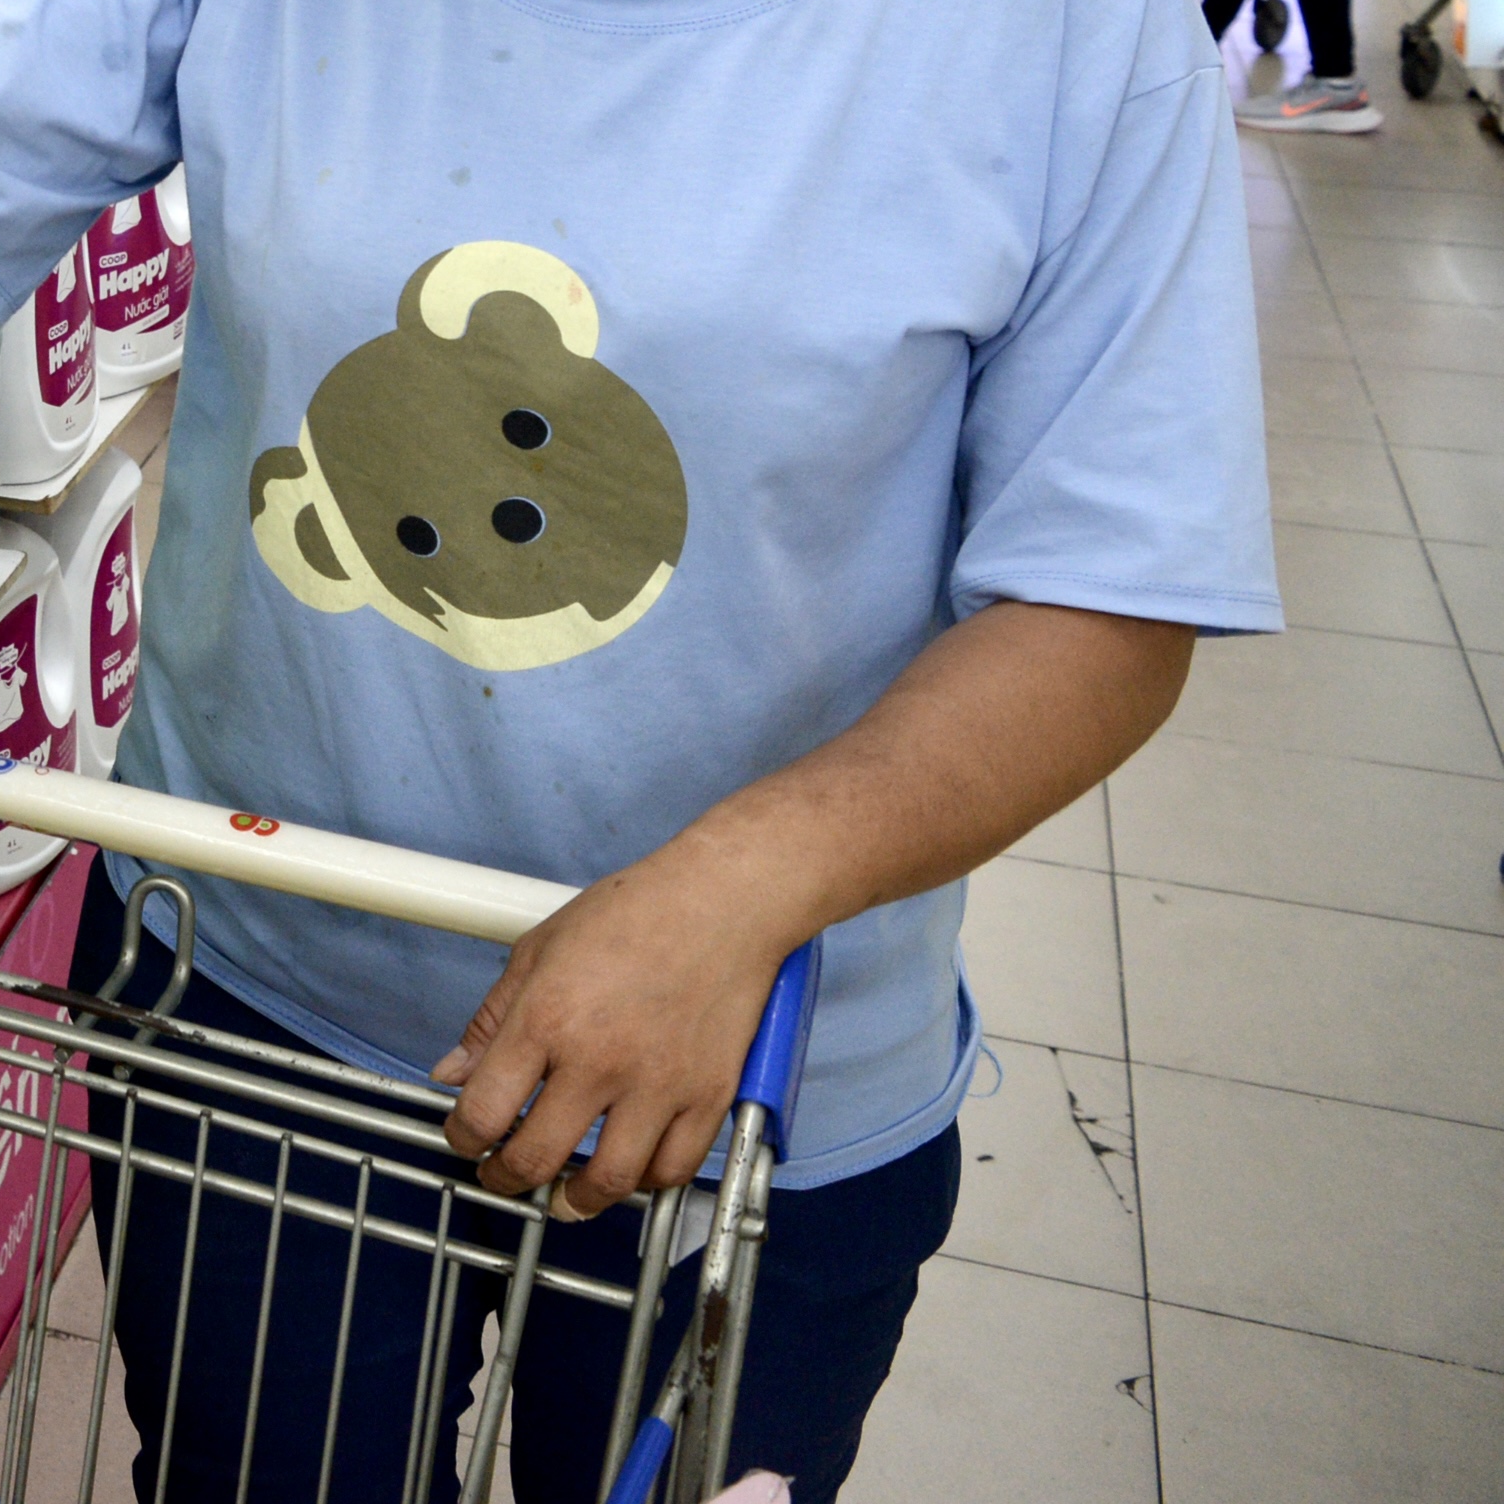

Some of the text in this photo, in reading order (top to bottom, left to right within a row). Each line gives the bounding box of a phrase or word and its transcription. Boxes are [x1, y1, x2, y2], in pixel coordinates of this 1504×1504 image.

[101, 254, 126, 266] COOP
[99, 248, 170, 300] Happy
[124, 299, 152, 322] Nước
